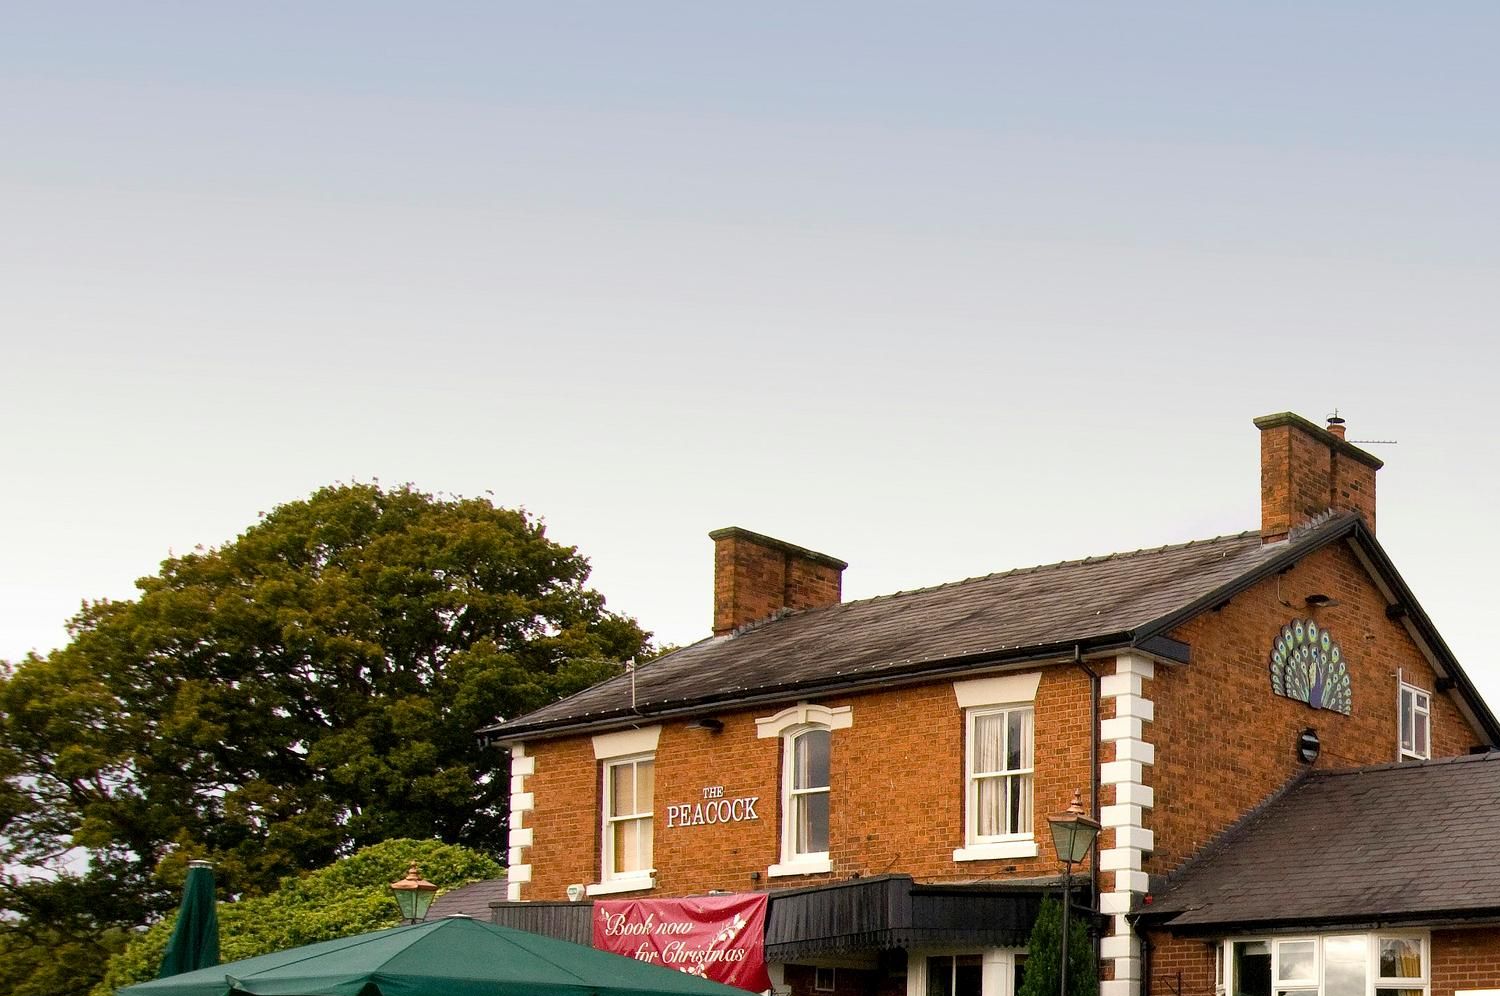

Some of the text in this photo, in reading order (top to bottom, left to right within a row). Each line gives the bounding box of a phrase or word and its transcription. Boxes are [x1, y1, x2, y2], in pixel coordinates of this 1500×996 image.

[703, 786, 724, 799] THE
[667, 797, 759, 828] PEACOCK
[605, 913, 695, 936] Book now
[634, 941, 745, 964] for Christmas
